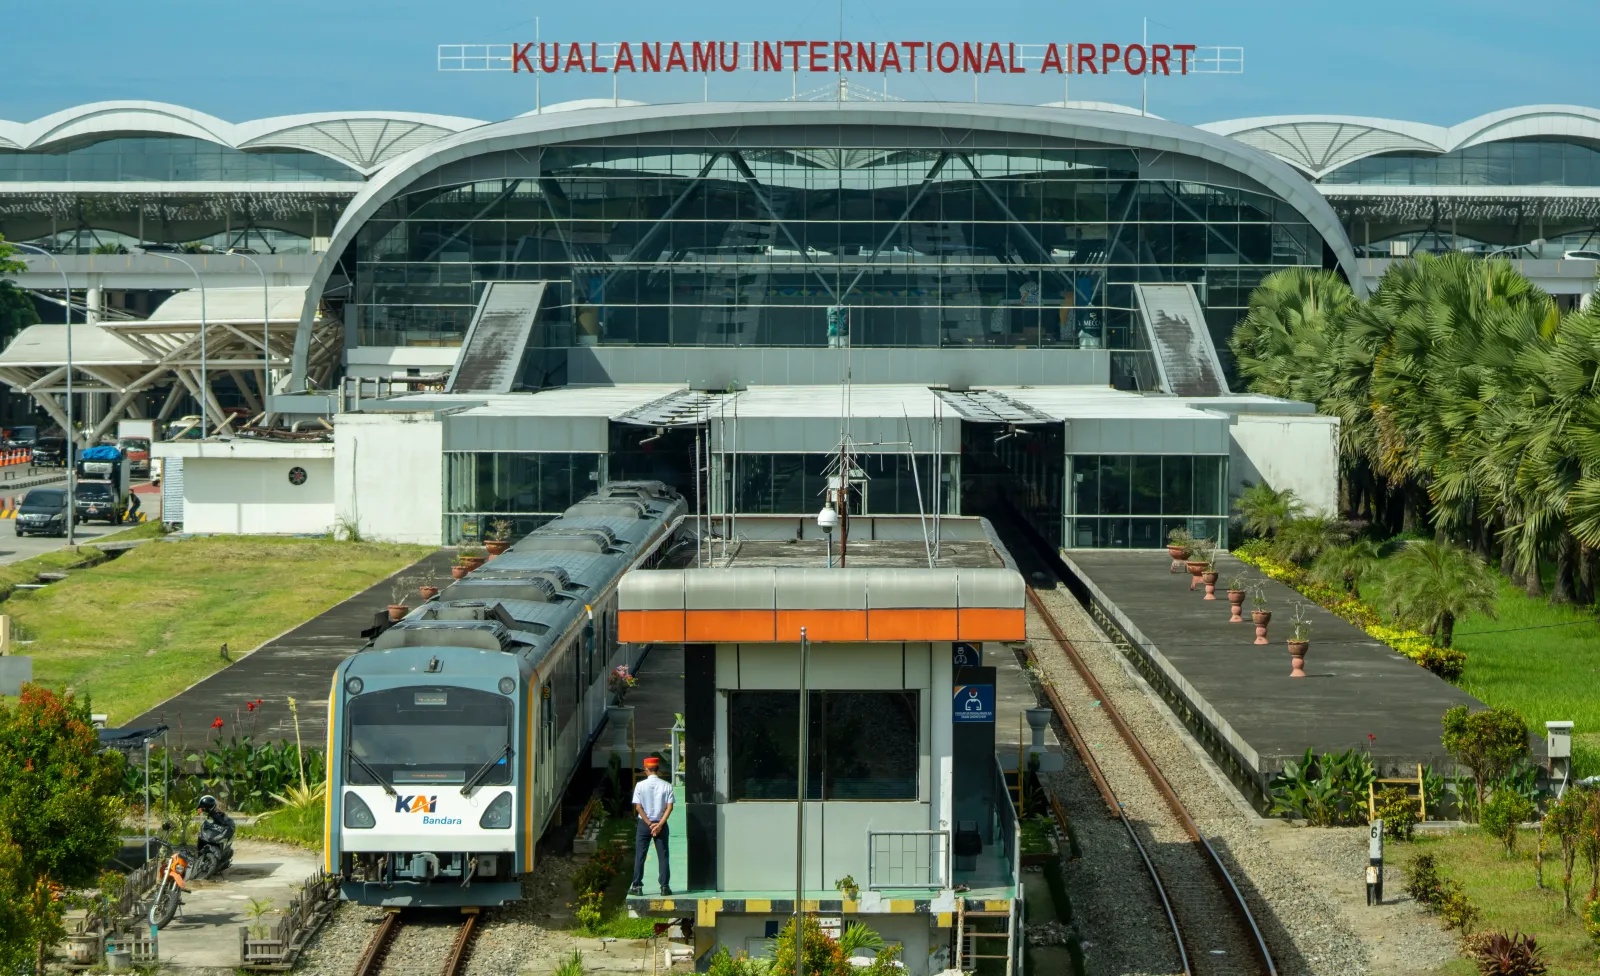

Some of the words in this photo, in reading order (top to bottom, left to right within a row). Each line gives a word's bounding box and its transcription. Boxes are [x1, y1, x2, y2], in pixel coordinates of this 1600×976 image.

[512, 42, 739, 73] KUALANAMU
[752, 41, 1026, 73] INTERNATIONAL
[1040, 42, 1197, 75] AIRPORT
[395, 795, 438, 813] KAI
[423, 815, 462, 825] Bandara
[1371, 826, 1378, 838] 6
